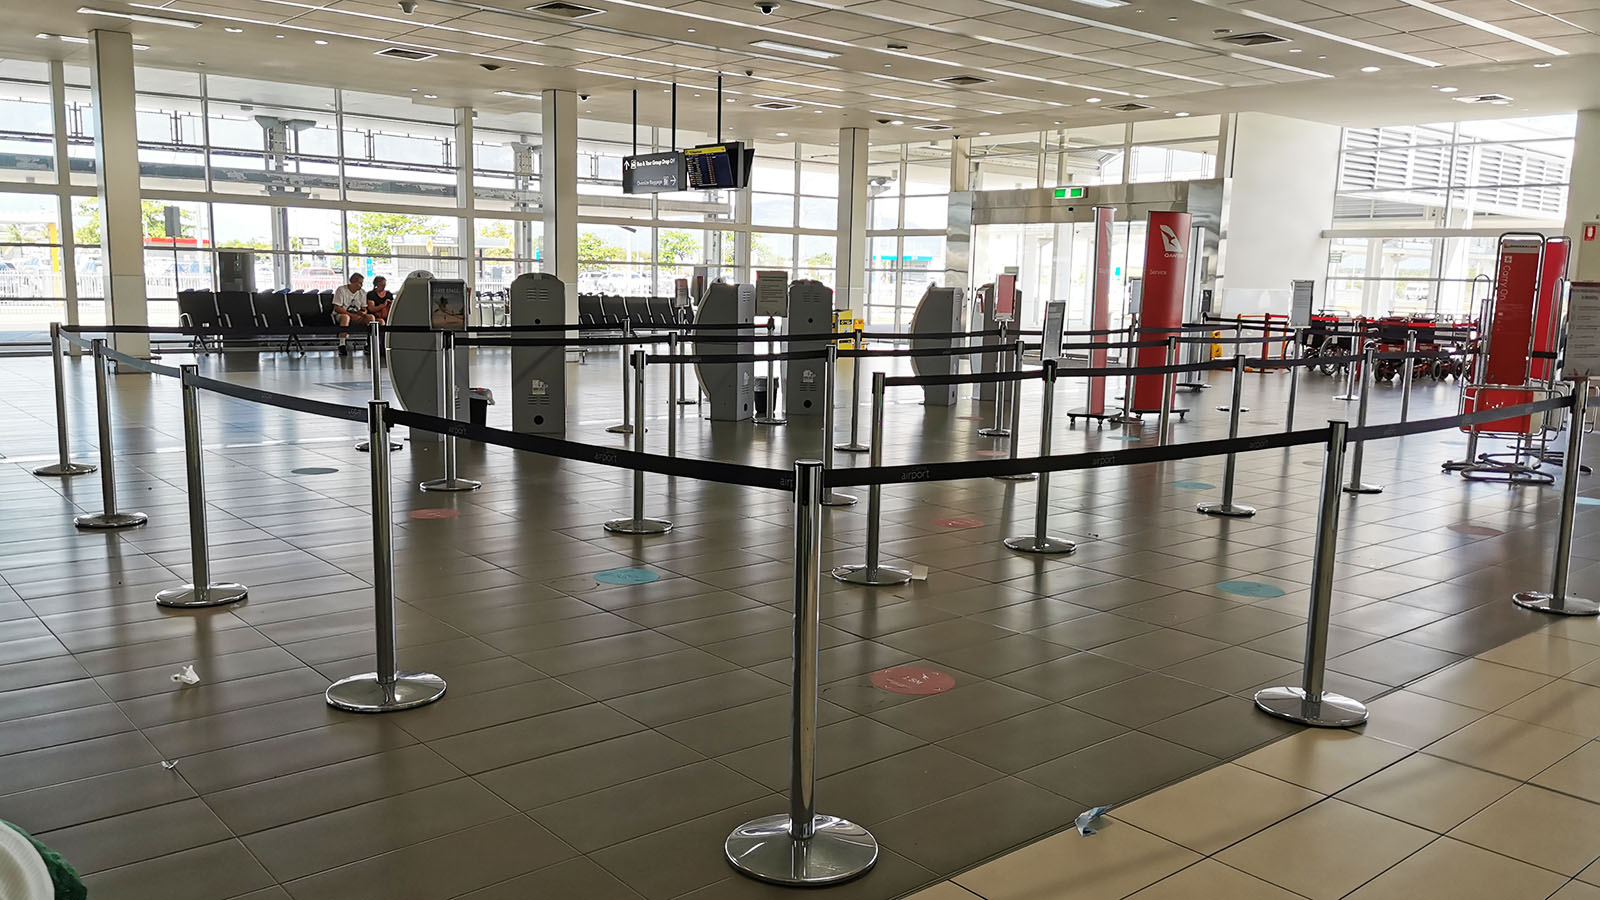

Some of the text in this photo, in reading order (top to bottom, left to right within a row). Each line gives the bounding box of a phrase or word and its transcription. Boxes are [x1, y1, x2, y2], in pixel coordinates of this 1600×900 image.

[1499, 265, 1512, 288] Carry
[1499, 288, 1509, 300] On
[594, 452, 617, 463] airport
[1092, 455, 1116, 466] airport
[900, 469, 930, 481] airport
